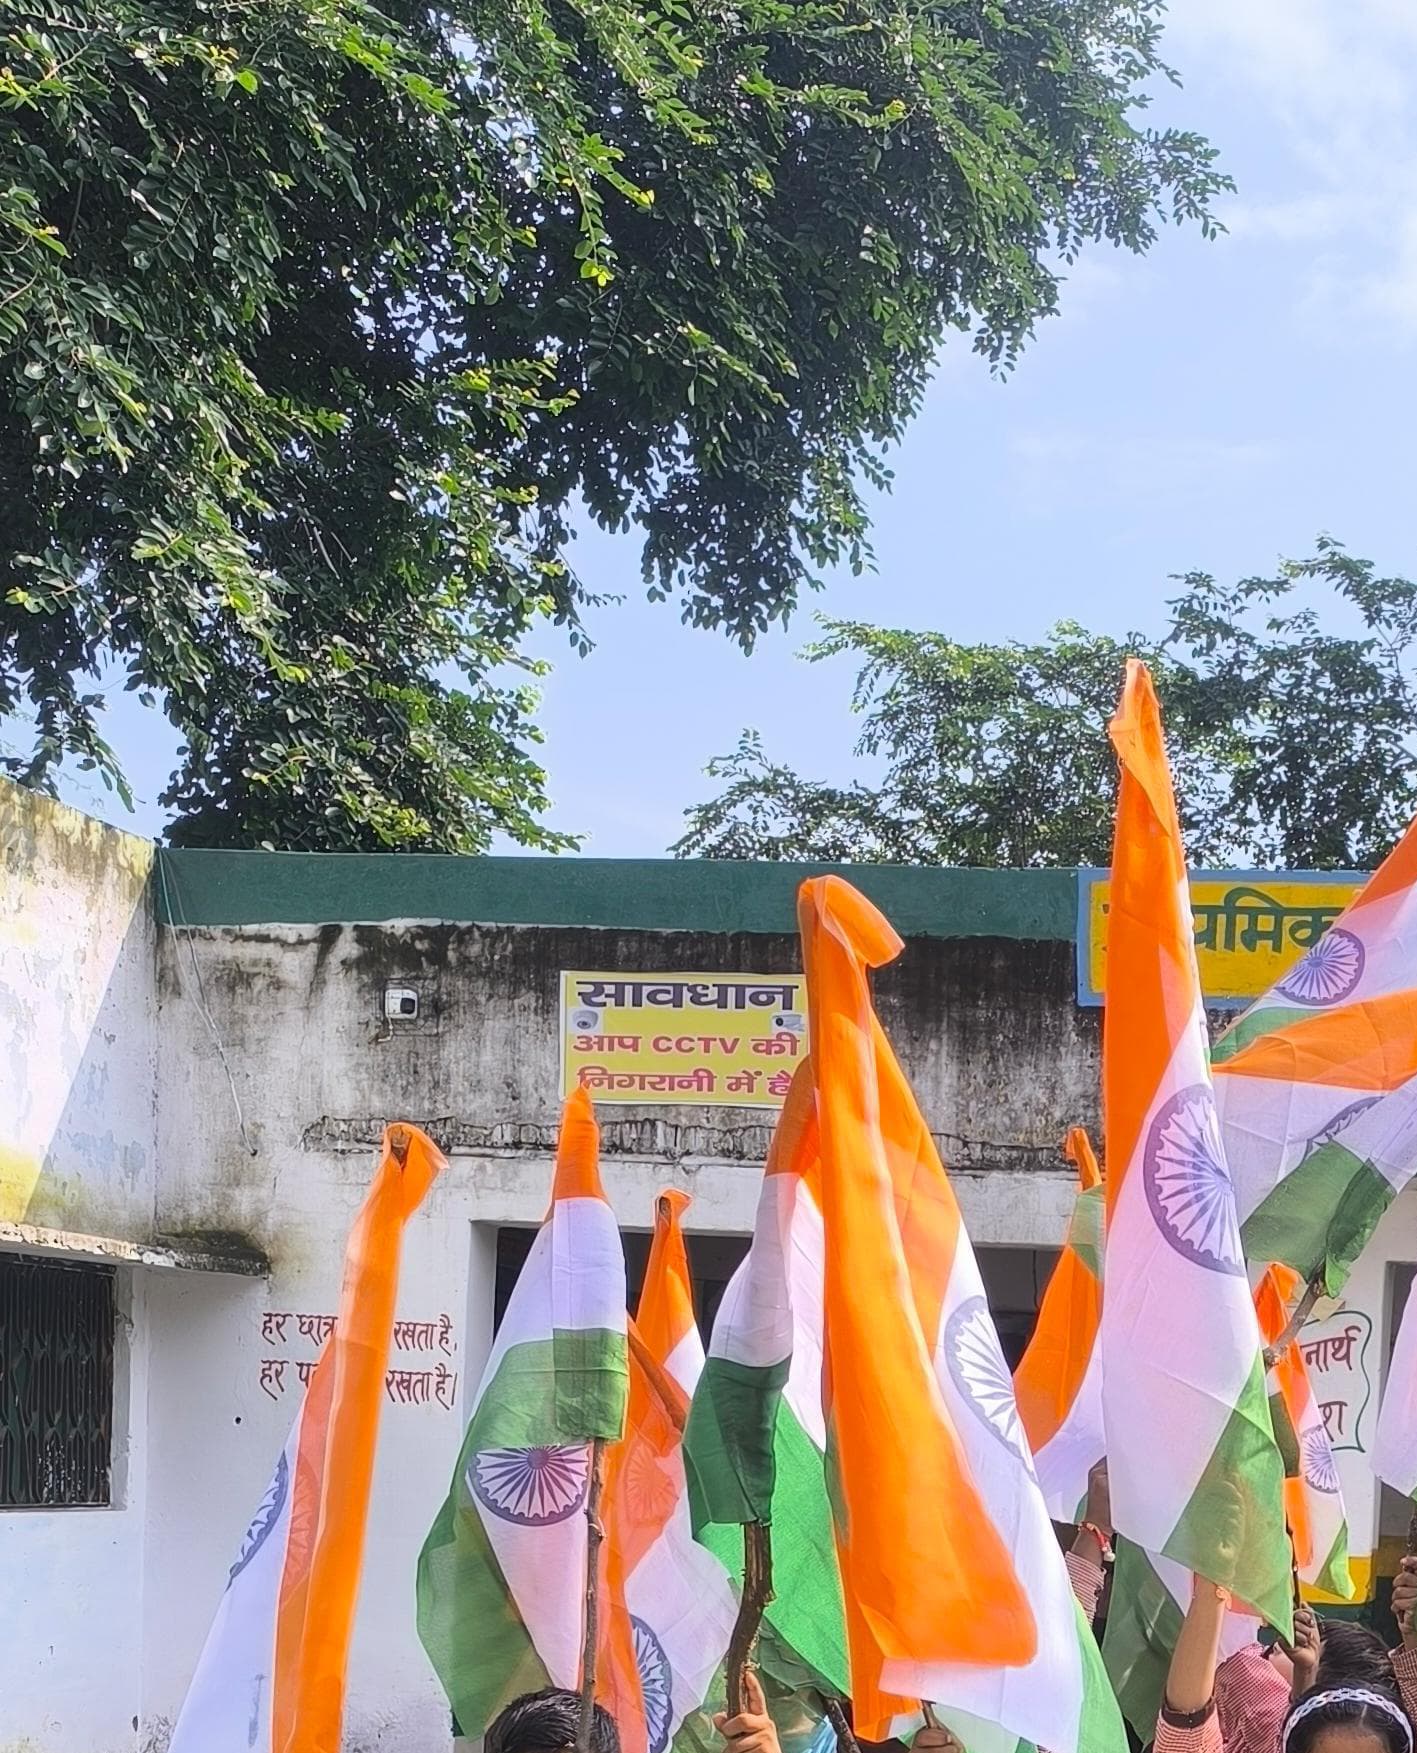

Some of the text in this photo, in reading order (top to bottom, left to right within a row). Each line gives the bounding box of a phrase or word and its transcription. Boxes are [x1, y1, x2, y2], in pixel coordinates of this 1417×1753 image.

[576, 980, 799, 1011] सावधान
[573, 1031, 801, 1056] आप CCTV की
[577, 1066, 717, 1092] निगरानी
[726, 1070, 763, 1094] में
[262, 1312, 293, 1346] हर
[260, 1359, 290, 1401] हर
[385, 1370, 433, 1405] रखता
